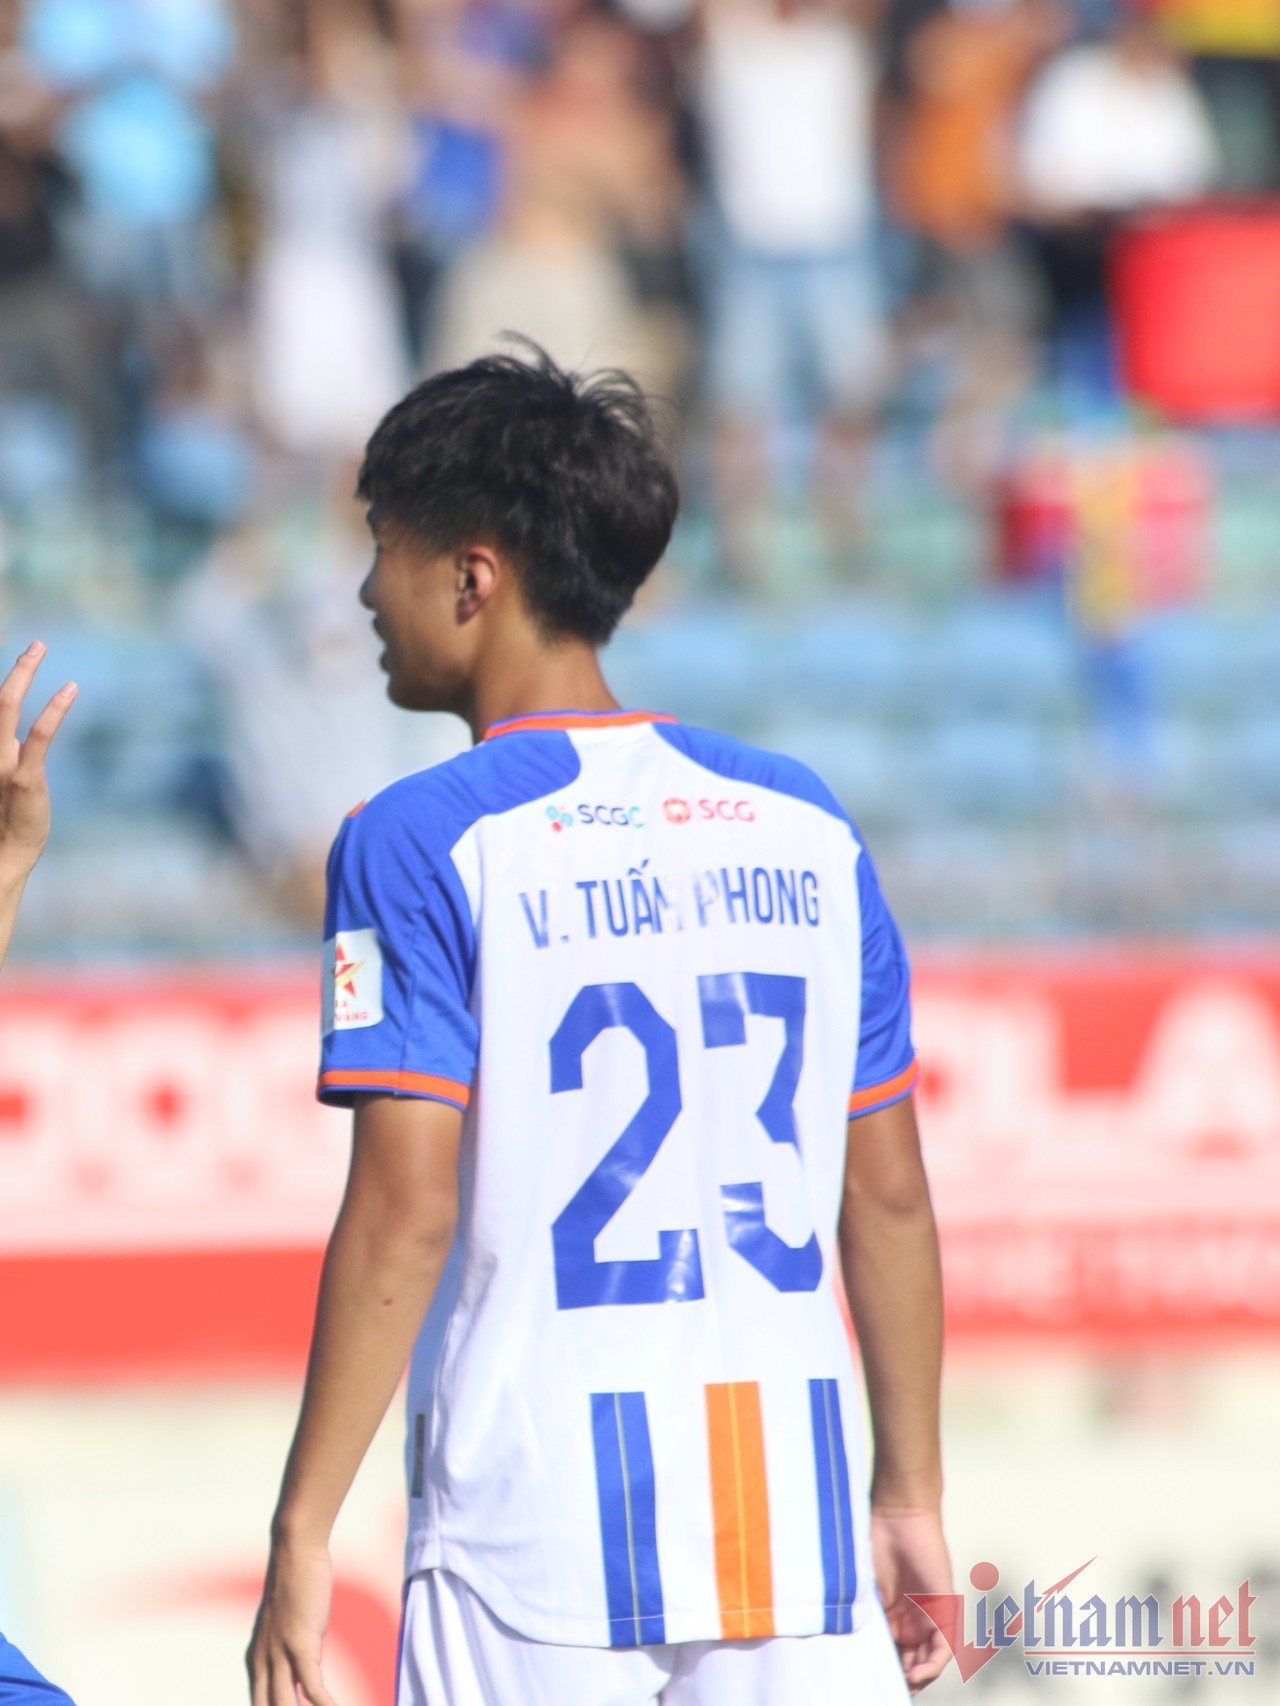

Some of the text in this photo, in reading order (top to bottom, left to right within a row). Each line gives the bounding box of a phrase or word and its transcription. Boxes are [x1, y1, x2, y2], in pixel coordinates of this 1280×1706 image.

[577, 803, 646, 829] SCGC
[698, 798, 756, 823] SCG
[693, 866, 820, 928] PHONG
[547, 971, 825, 1311] 23
